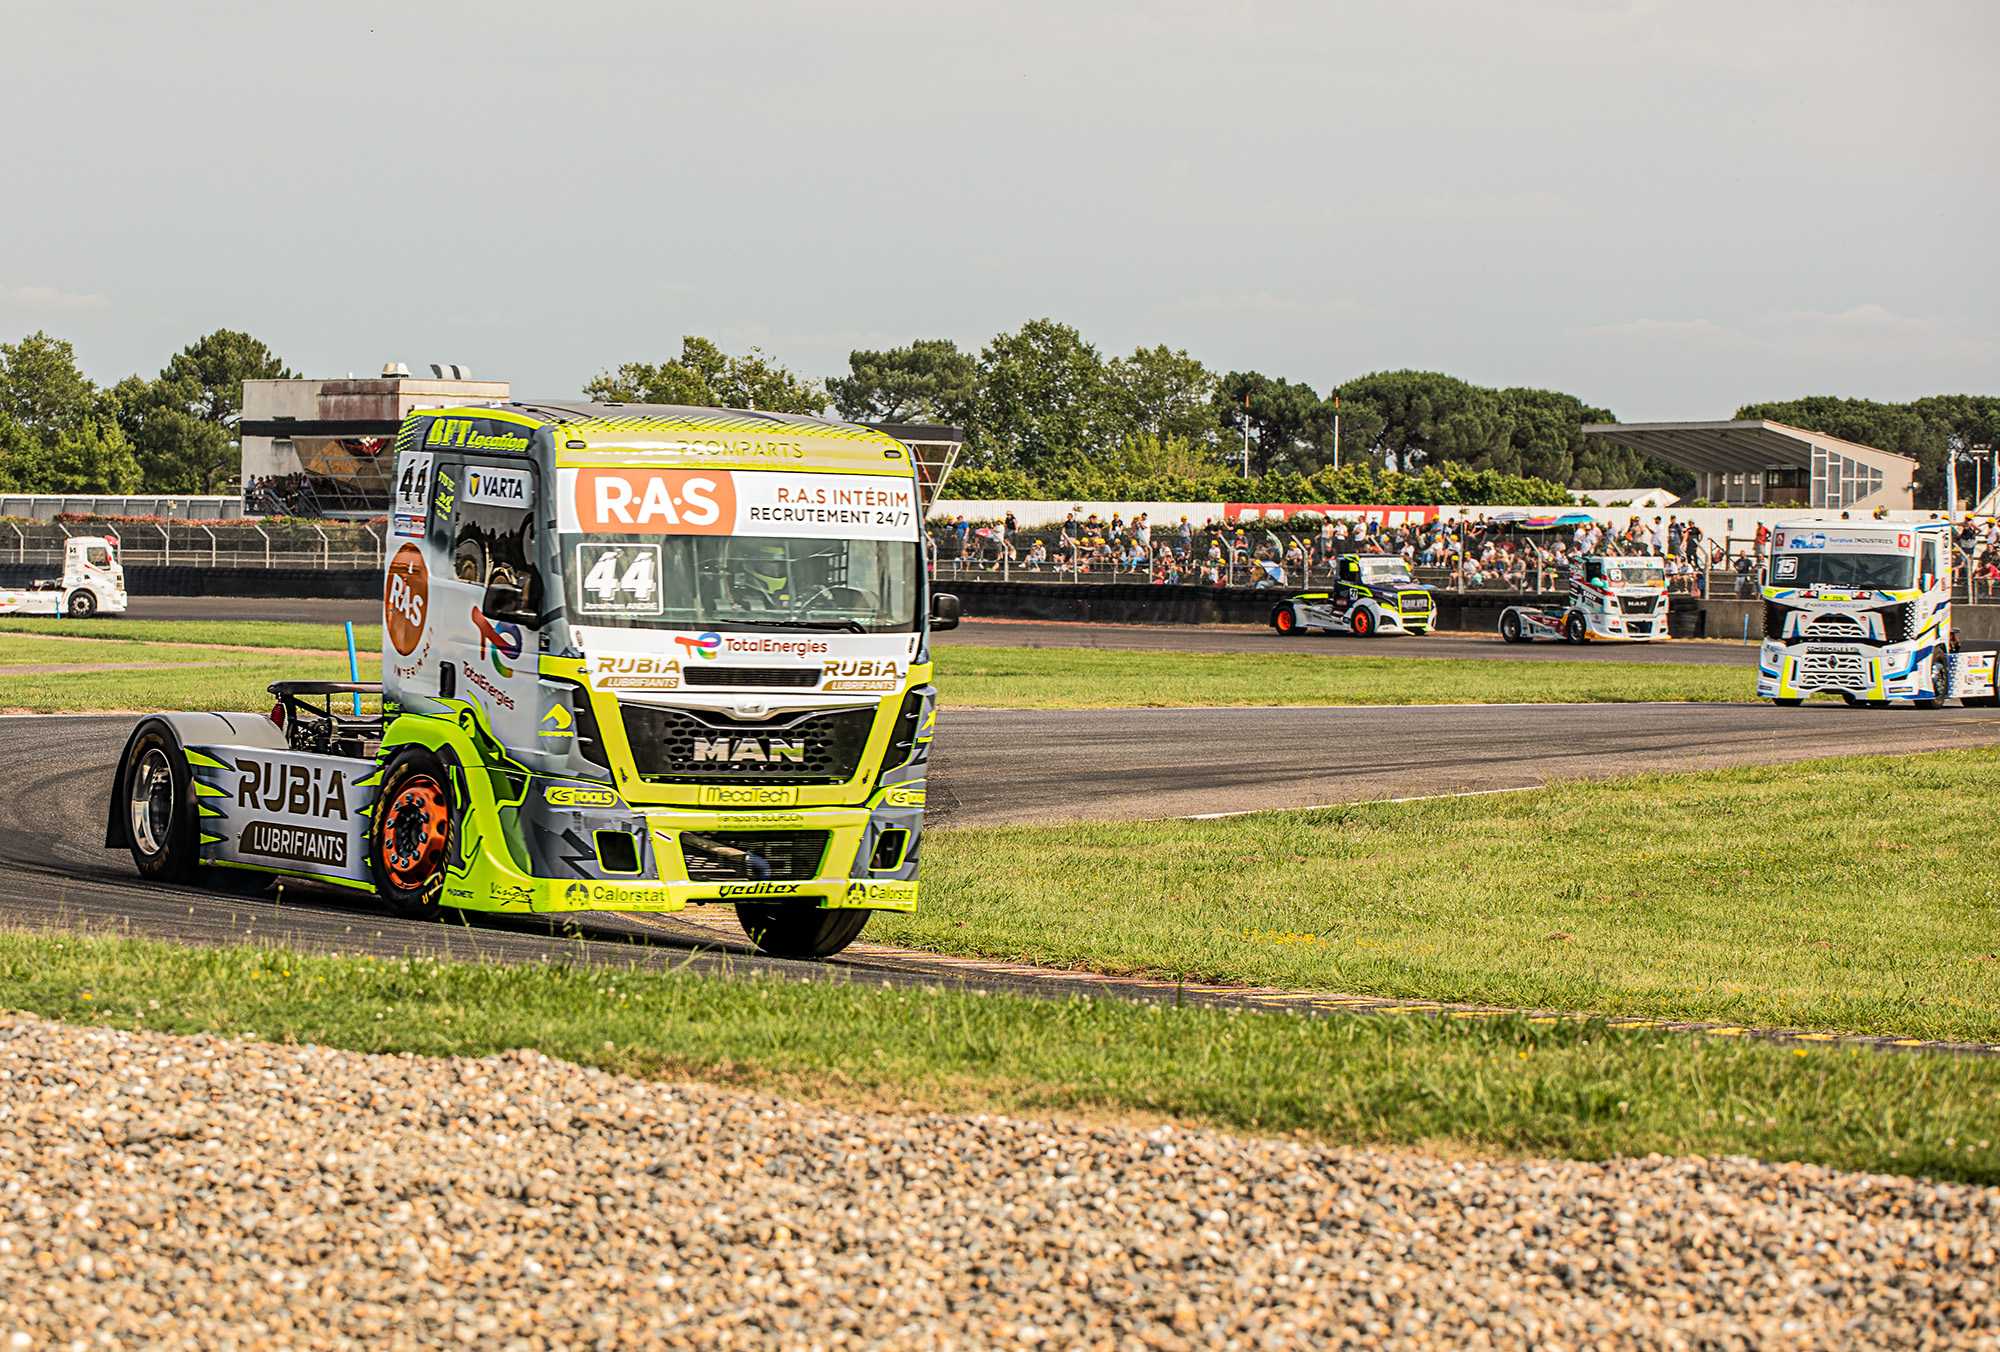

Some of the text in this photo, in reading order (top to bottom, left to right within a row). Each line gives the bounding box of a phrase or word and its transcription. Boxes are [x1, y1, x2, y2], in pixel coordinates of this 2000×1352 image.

[466, 430, 529, 452] Location
[399, 459, 430, 505] 44
[483, 475, 524, 500] VARTA
[832, 486, 909, 508] INTÉRIM
[750, 506, 911, 528] RECRUTEMENT 24/7
[584, 551, 658, 601] 44
[1776, 558, 1797, 574] 15
[725, 637, 828, 656] TotalEnergies
[462, 660, 517, 712] TotalEnergies
[606, 677, 678, 688] LUBRIFIANTS
[831, 679, 897, 691] LUBRIFIANTS
[692, 738, 806, 763] MAN
[574, 791, 613, 804] TOOLS
[254, 826, 344, 863] LUBRIFIANTS
[592, 886, 666, 902] Calorstat
